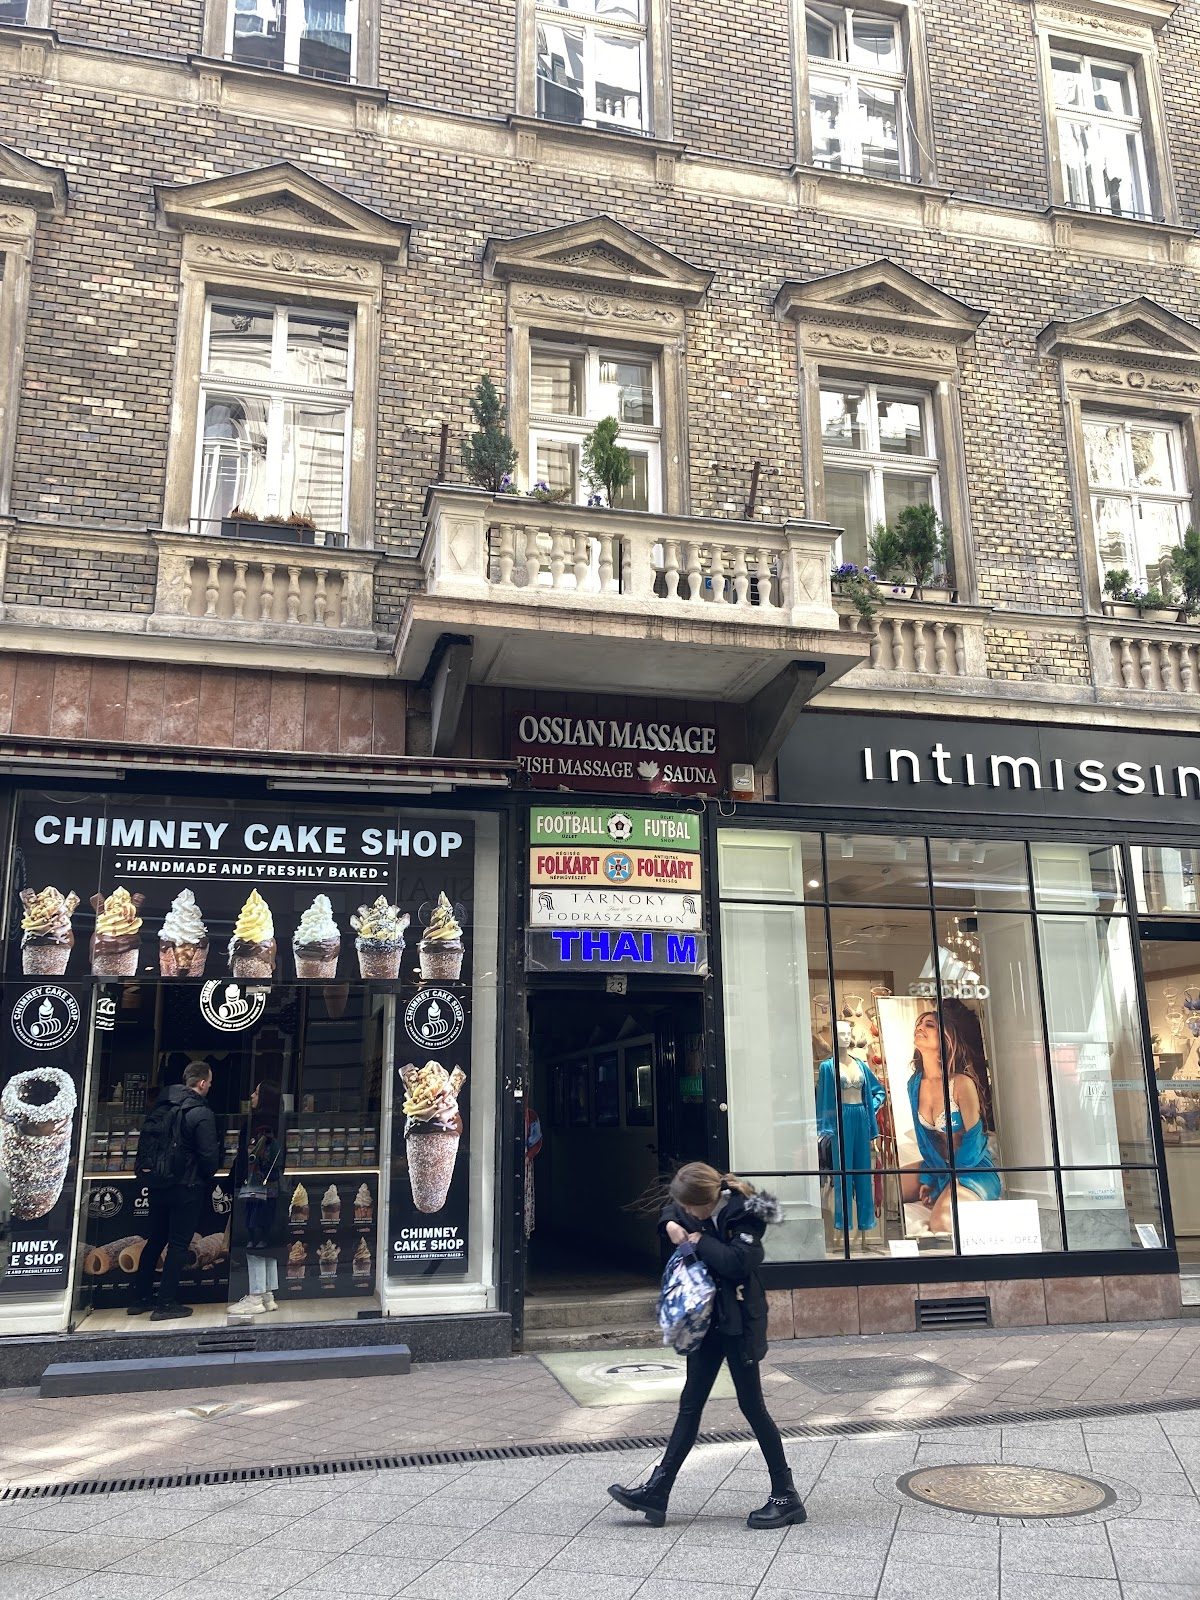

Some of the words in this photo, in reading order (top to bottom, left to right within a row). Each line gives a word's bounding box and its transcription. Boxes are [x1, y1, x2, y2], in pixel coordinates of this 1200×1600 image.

[519, 715, 606, 747] OSSIAN
[608, 720, 717, 755] MASSAGE
[516, 756, 554, 774] FISH
[558, 758, 634, 778] MASSAGE
[662, 764, 718, 784] SAUNA
[536, 815, 606, 834] FOOTBALL
[644, 818, 691, 840] FUTBAL
[34, 815, 229, 850] CHIMNEY
[243, 823, 347, 855] CAKE
[360, 828, 463, 858] SHOP
[126, 860, 217, 875] HANDMADE
[220, 862, 254, 876] AND
[257, 864, 325, 878] FRESHLY
[328, 866, 379, 879] BAKED
[537, 855, 600, 875] FOLKART
[637, 858, 694, 880] FOLKART
[571, 892, 667, 906] TÁRNOKY
[548, 912, 621, 922] FODRÁSZ
[627, 913, 685, 924] SZALON
[552, 930, 654, 963] THAI
[667, 934, 697, 964] M
[13, 988, 43, 1020] CHIMNEY
[45, 987, 68, 1000] CAKE
[66, 997, 78, 1021] SHOP
[406, 991, 430, 1021] CHIMNEY
[432, 990, 453, 1002] CAKE
[451, 1000, 463, 1021] SHOP
[135, 1198, 149, 1207] CA
[401, 1226, 458, 1239] CHIMNEY
[1010, 1235, 1038, 1245] OPEZ
[11, 1240, 59, 1253] IMNEY
[394, 1240, 427, 1252] CAKE
[430, 1239, 464, 1250] SHOP
[24, 1253, 64, 1266] SHOP
